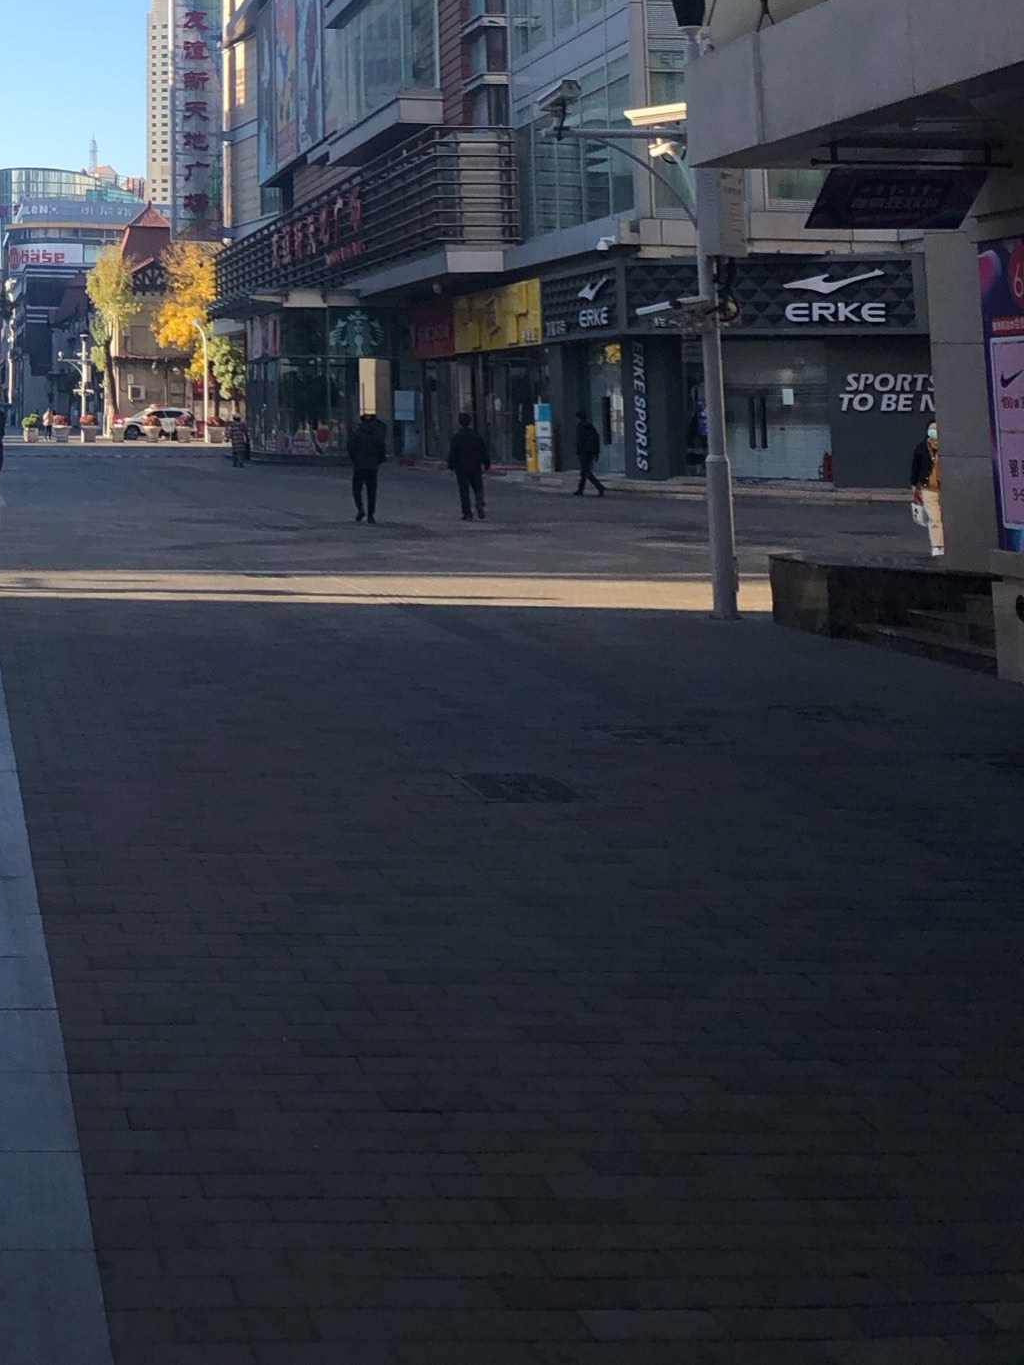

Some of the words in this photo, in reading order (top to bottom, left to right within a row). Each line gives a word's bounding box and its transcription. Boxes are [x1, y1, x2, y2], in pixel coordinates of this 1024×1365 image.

[183, 10, 210, 213] 友谊新天地广场
[578, 306, 609, 328] ERKE
[784, 302, 886, 323] ERKE
[631, 339, 652, 392] ERKE
[839, 393, 875, 412] TO
[880, 393, 914, 412] BE
[919, 393, 935, 413] N
[632, 394, 650, 472] SPORTS
